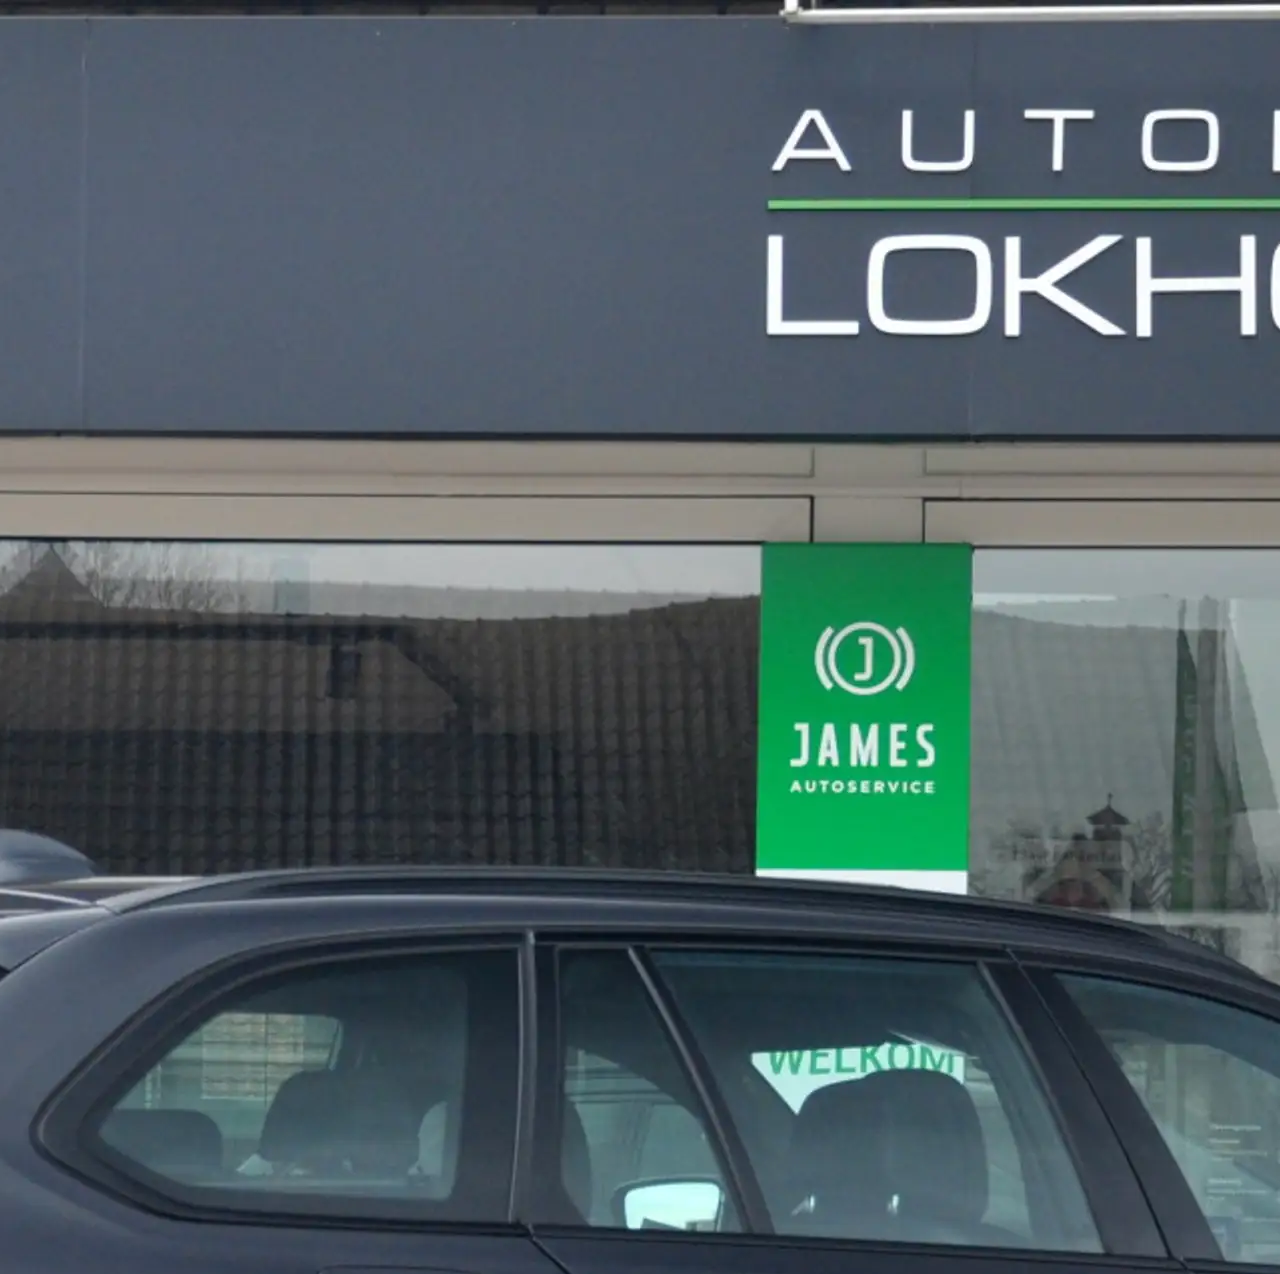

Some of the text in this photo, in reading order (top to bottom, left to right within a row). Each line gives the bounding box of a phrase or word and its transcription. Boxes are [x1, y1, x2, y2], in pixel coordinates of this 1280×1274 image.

[789, 722, 936, 768] JAMES
[790, 779, 936, 794] AUTOSERVICE
[769, 1045, 954, 1075] WELKOM
